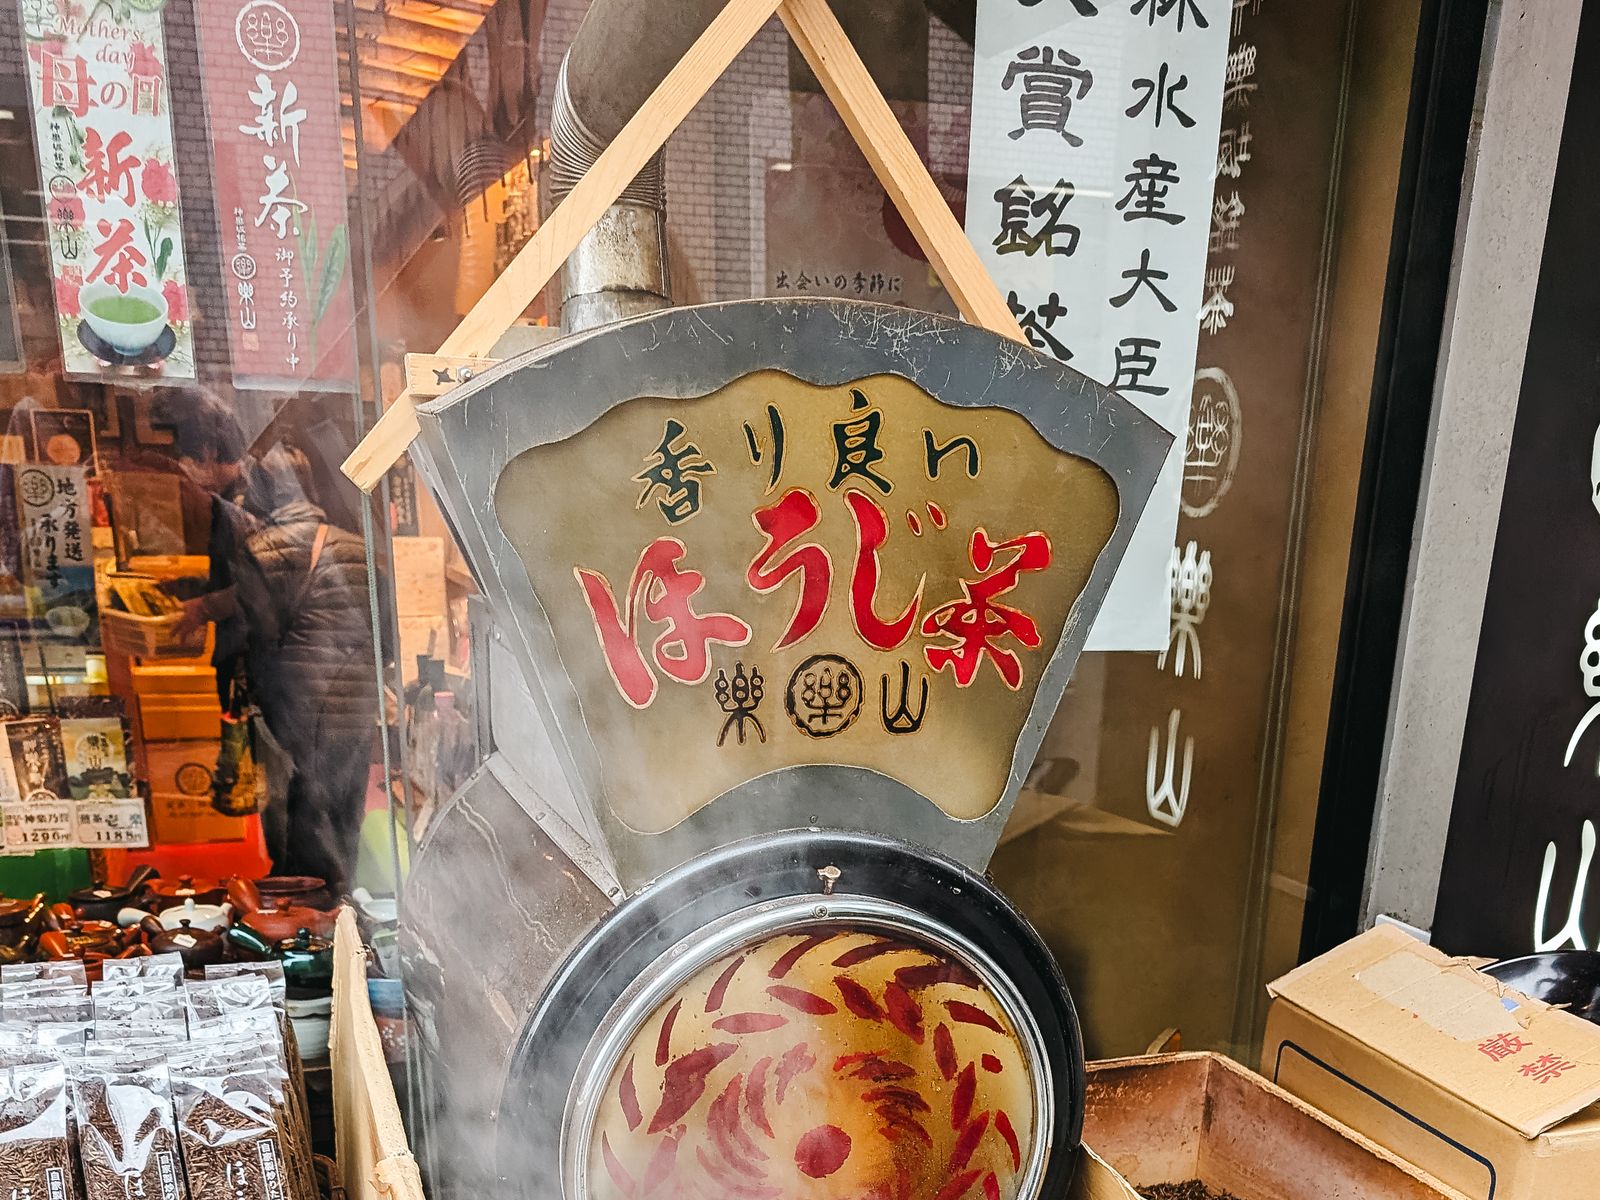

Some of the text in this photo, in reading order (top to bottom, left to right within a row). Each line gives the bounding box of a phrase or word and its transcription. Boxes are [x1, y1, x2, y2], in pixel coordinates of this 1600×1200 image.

[37, 49, 161, 118] 母の日
[76, 127, 148, 294] 新茶
[238, 73, 309, 239] 新茶
[993, 0, 1098, 361] 賞銘茶
[275, 247, 300, 372] 御予約承り中
[776, 270, 903, 294] 出会いの季節に
[56, 477, 83, 561] 地方発送
[631, 389, 982, 525] 香り良い
[573, 487, 1054, 709] ほうじ茶
[1478, 1032, 1576, 1084] 厳禁
